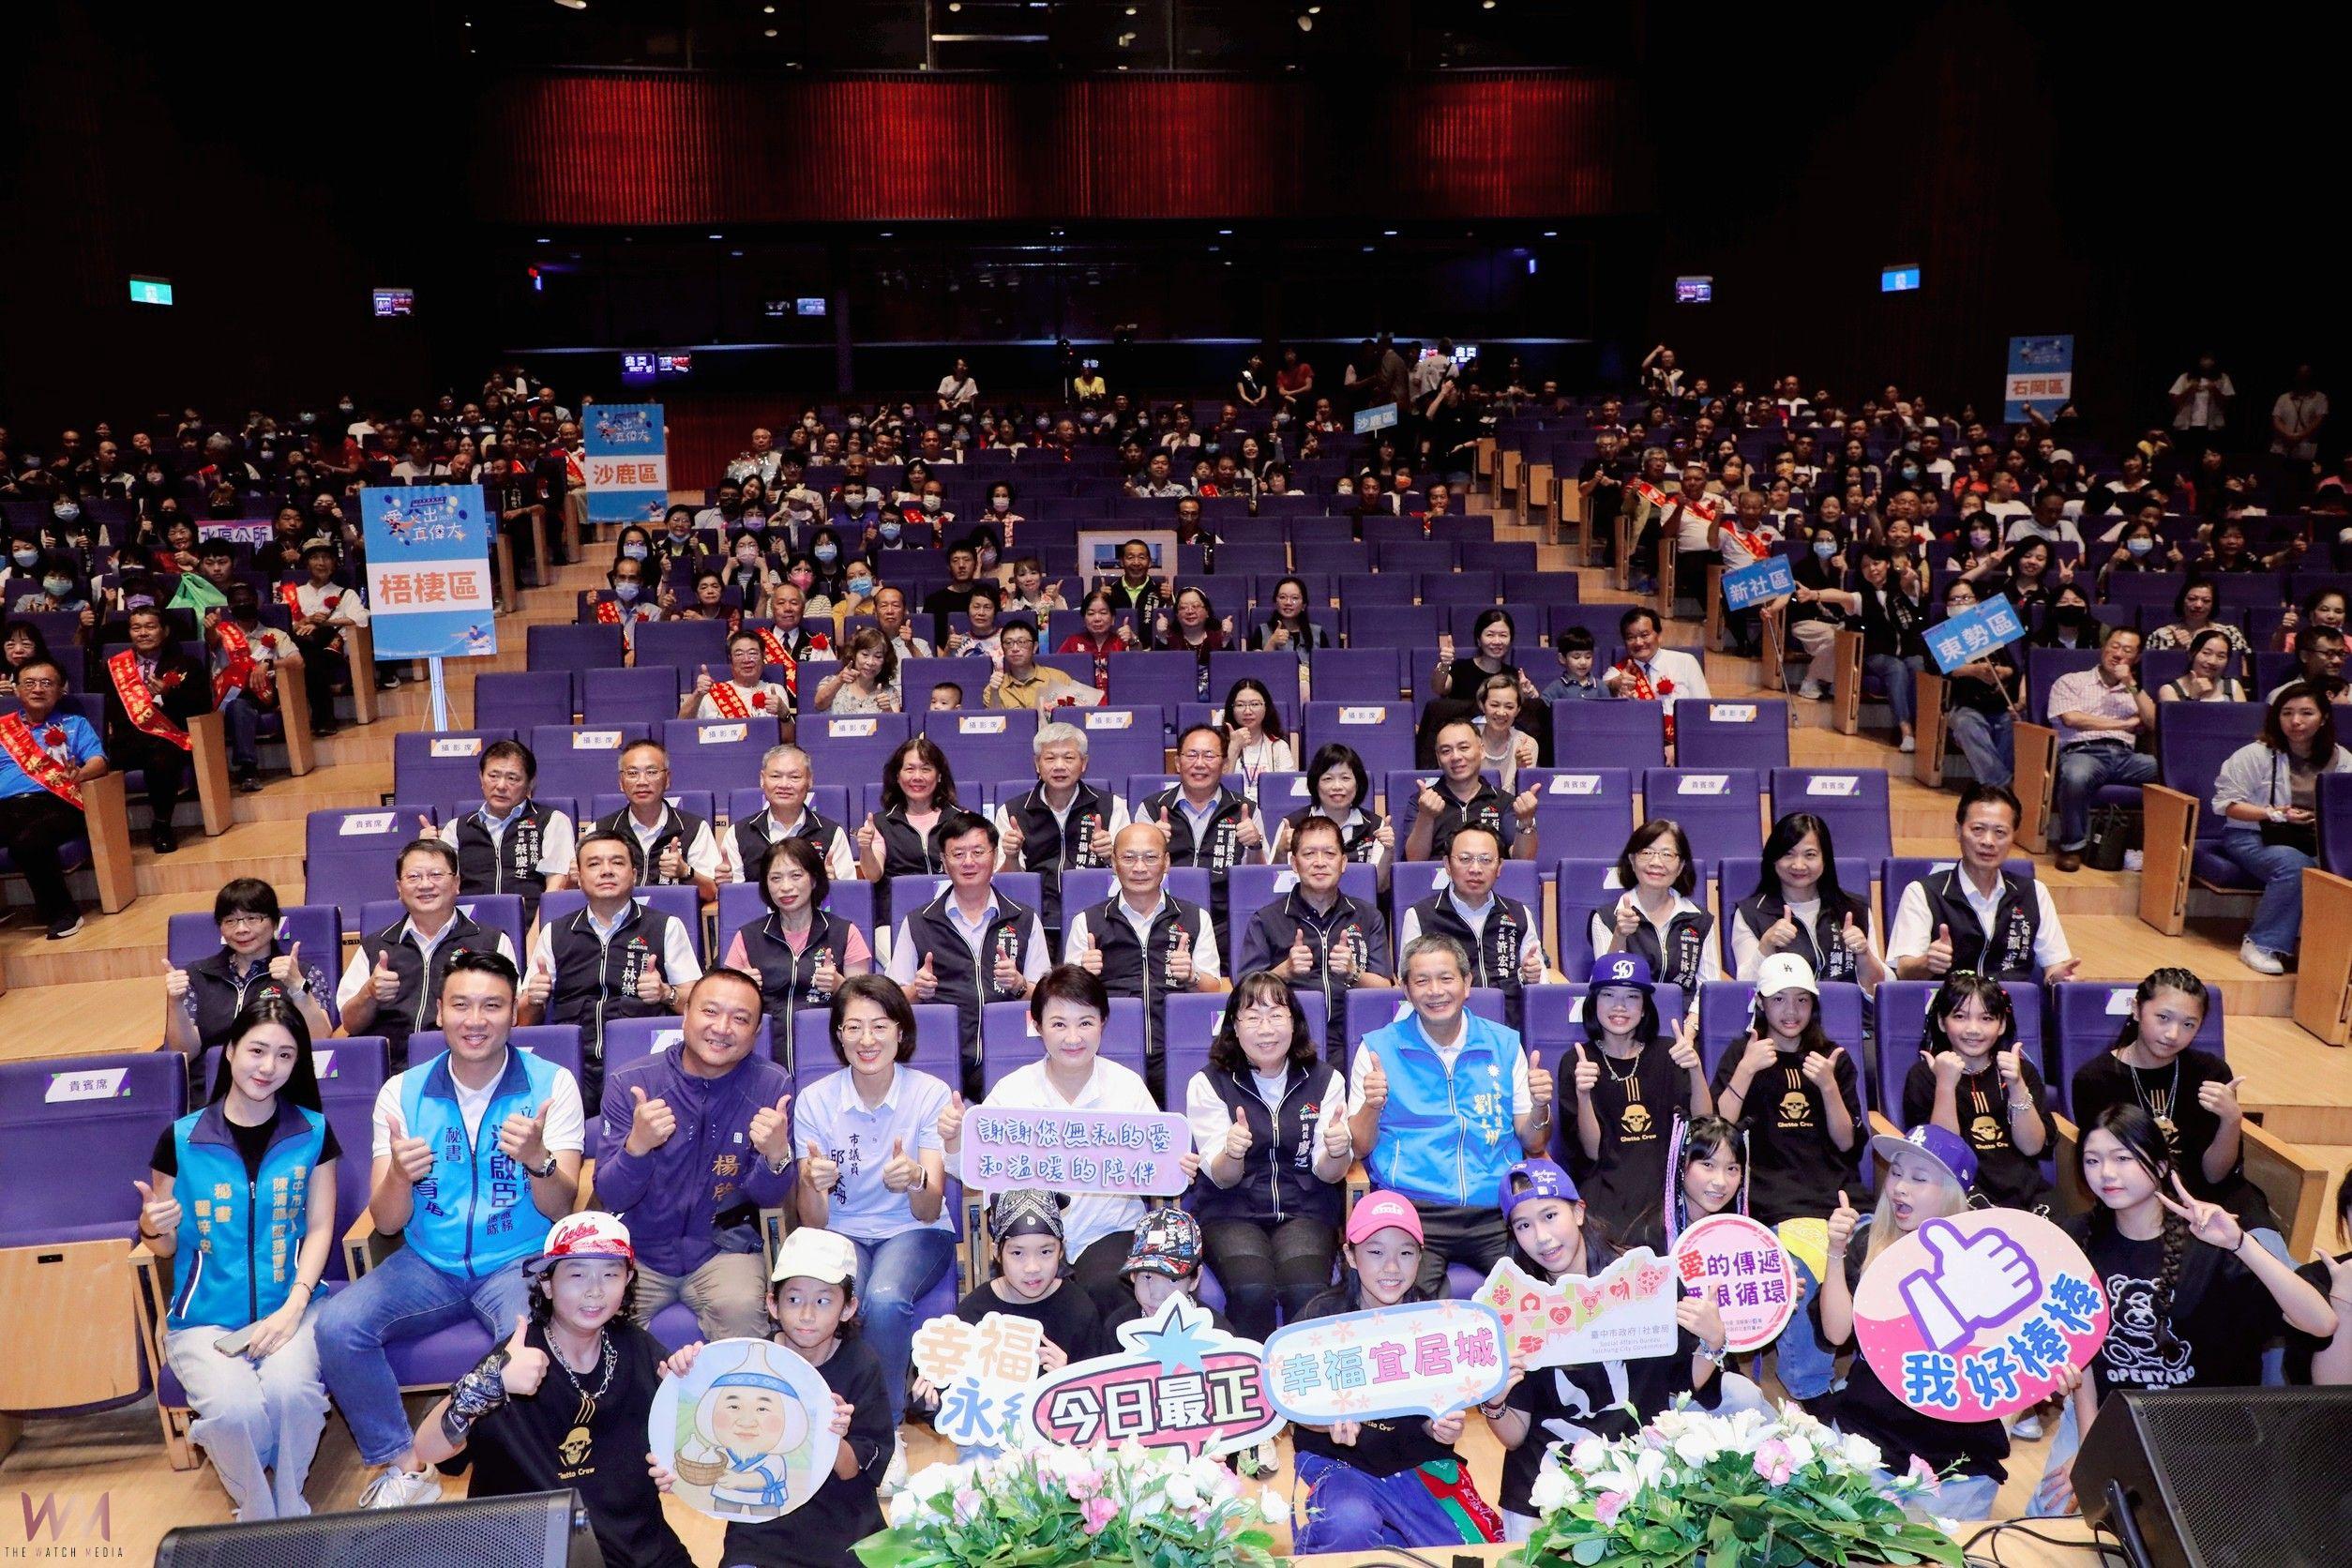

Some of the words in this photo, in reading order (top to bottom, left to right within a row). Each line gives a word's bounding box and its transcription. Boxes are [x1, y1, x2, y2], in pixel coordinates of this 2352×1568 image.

[594, 463, 658, 485] 沙鹿區
[380, 570, 479, 605] 梧棲區
[1728, 568, 1791, 603] 新社區
[1937, 611, 2016, 663] 東勢區
[69, 1078, 108, 1092] 貴賓席
[445, 1126, 462, 1162] 秘書
[978, 1118, 1170, 1152] 謝謝您無私的愛
[849, 1133, 861, 1176] 市議員
[981, 1154, 1155, 1185] 和溫暖的陪伴
[215, 1183, 232, 1223] 秘書
[555, 1223, 598, 1246] Cubs
[1679, 1249, 1781, 1282] 愛的傳遞
[1591, 1327, 1636, 1339] 臺中市政府
[1643, 1324, 1669, 1335] 社會局
[1906, 1274, 2101, 1407] 我好棒棒
[919, 1319, 1035, 1383] 幸福
[1281, 1328, 1498, 1396] 幸福宜居城
[2107, 1365, 2194, 1384] OPENYARD
[1051, 1364, 1265, 1445] 今日最正
